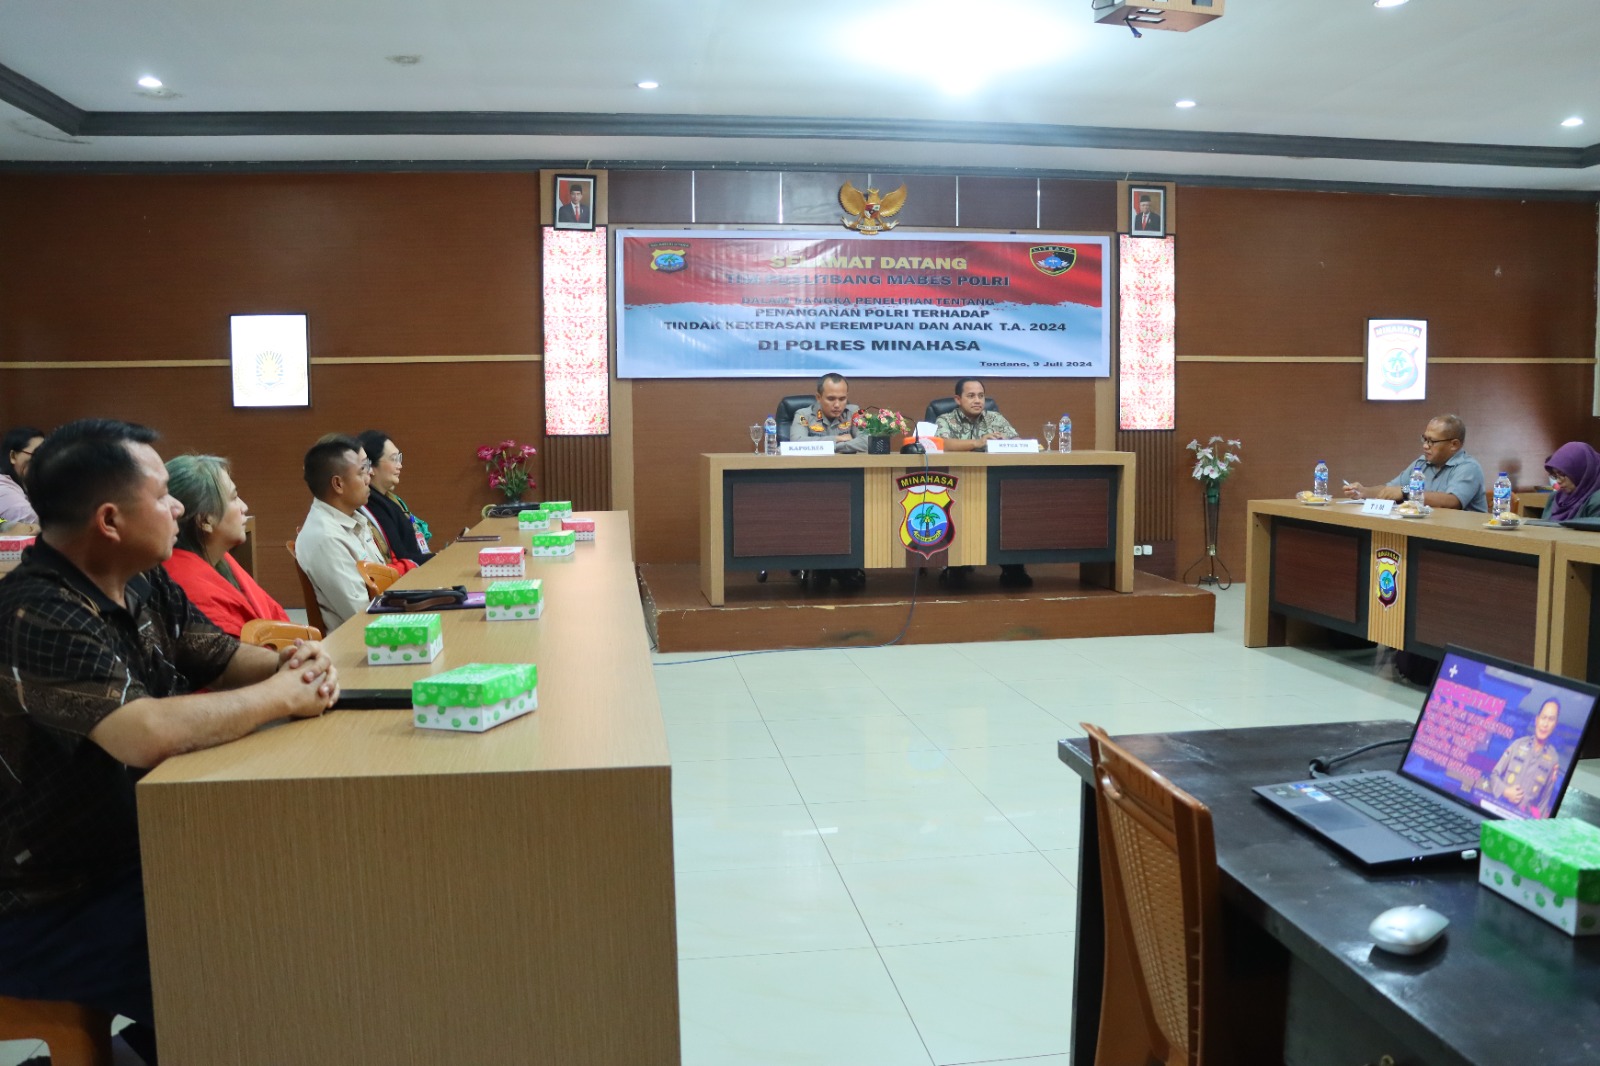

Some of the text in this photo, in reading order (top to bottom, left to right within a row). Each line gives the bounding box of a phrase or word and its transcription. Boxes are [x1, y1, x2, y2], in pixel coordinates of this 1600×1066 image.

[769, 255, 967, 270] SELAMAT DATANG
[765, 273, 881, 285] PUSLITBANG
[887, 275, 952, 286] MABES
[957, 276, 1010, 286] POLRI
[855, 297, 933, 305] PENELITIAN
[937, 298, 995, 306] TENTANG
[755, 308, 990, 318] PENANGANAN POLRI TERHADAP
[664, 321, 1067, 332] TINDAK KEKERASAN PEREMPUAN DAN ANAK T.A. 2024
[758, 340, 981, 351] DI POLRES MINAHASA
[900, 475, 954, 487] MINAHASA
